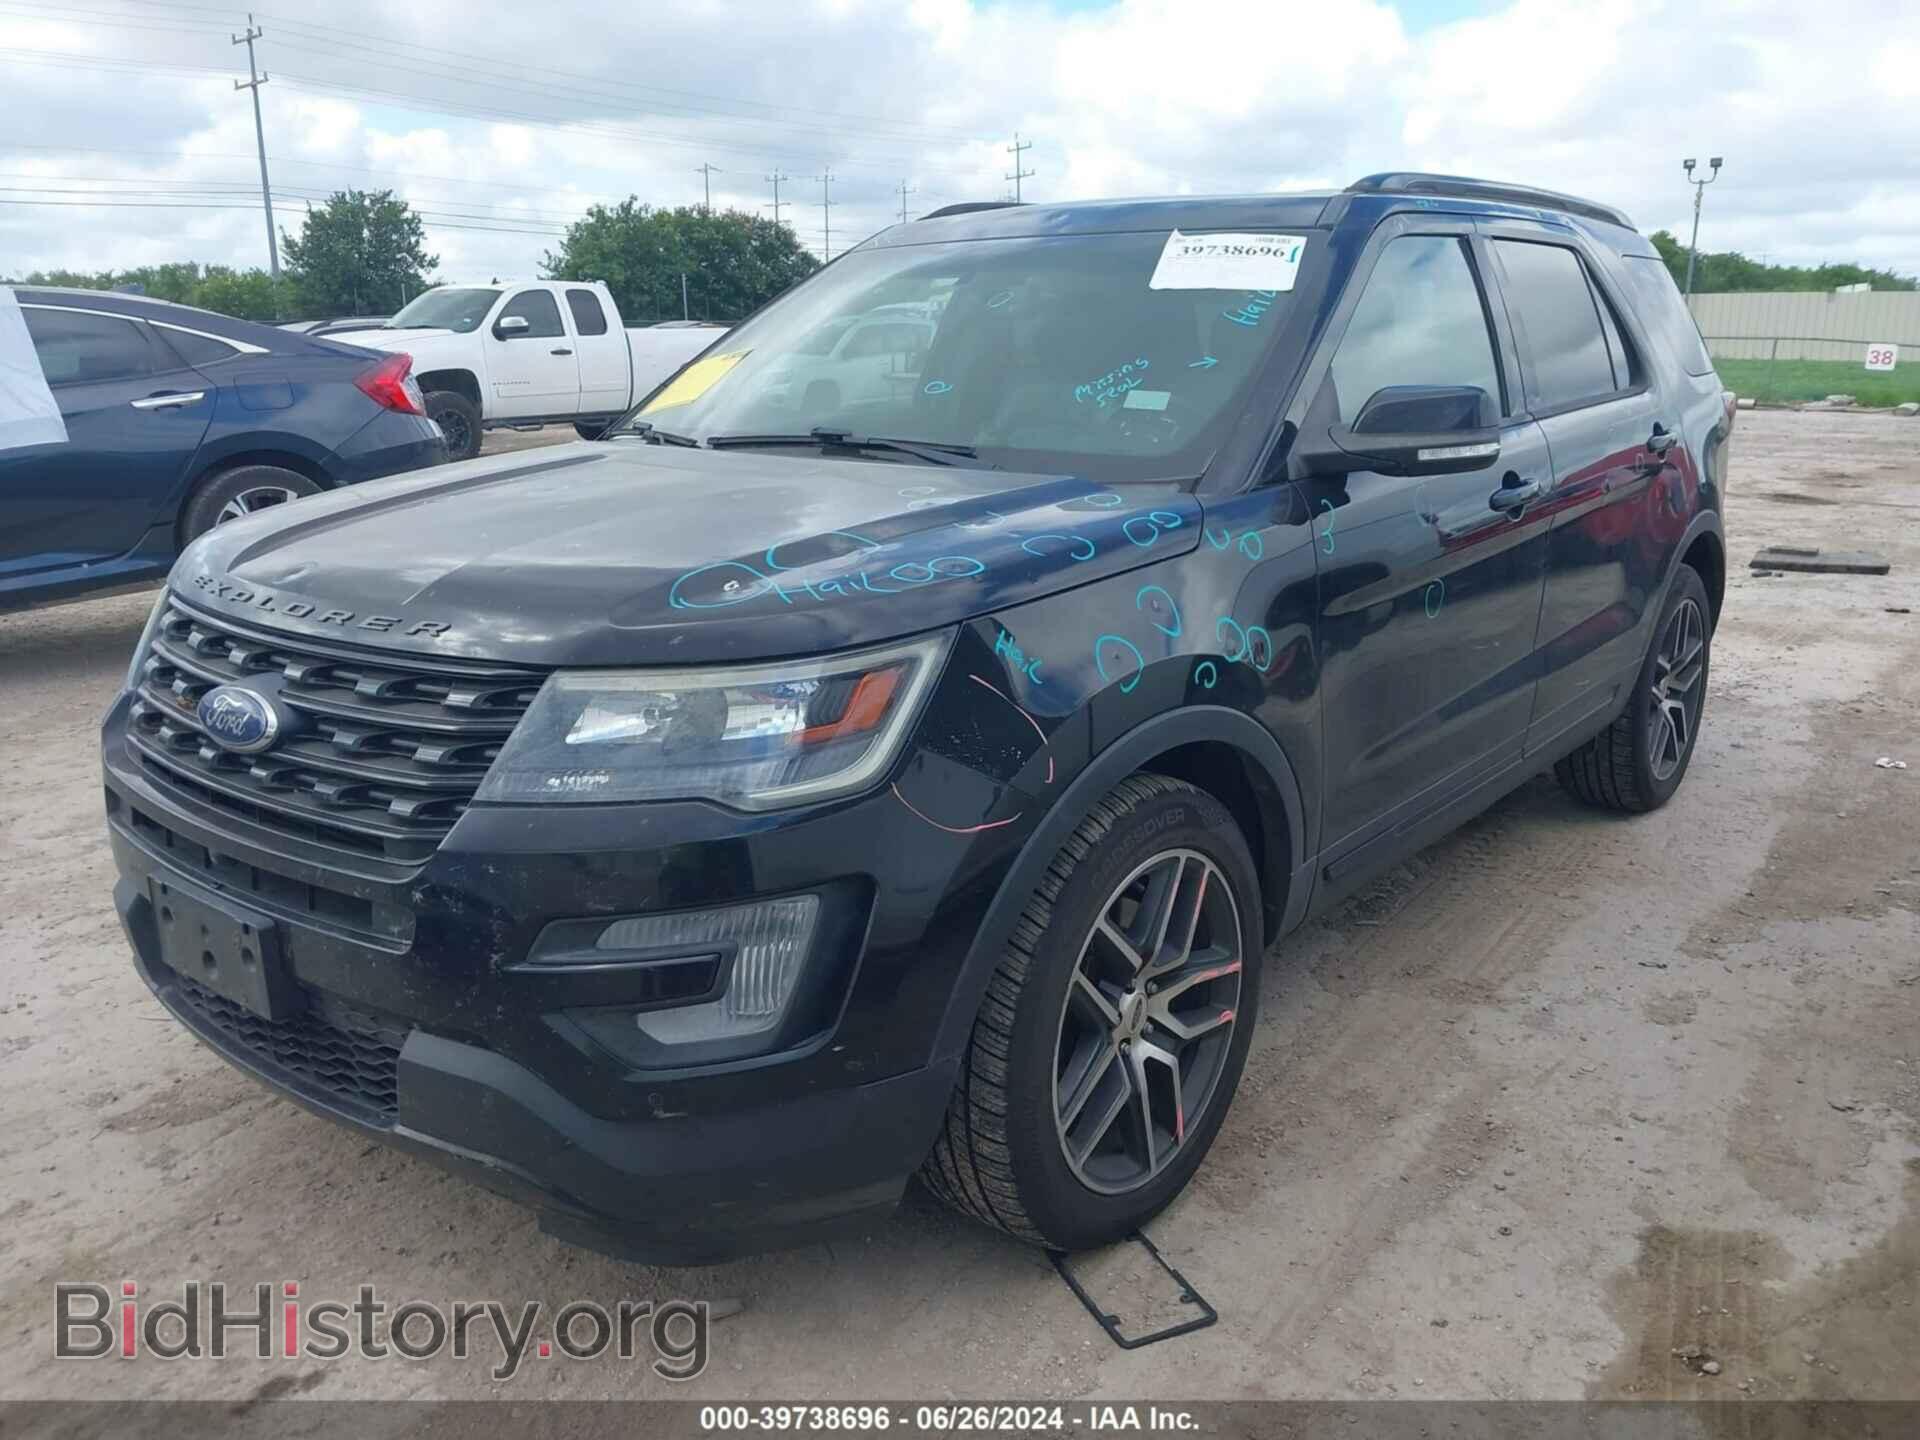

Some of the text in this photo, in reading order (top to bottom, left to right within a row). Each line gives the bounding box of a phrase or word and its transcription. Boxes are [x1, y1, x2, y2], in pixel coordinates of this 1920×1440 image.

[1177, 244, 1286, 258] 39738696
[1869, 350, 1894, 365] 38
[194, 575, 453, 638] EXPLORER
[205, 694, 250, 736] Ford
